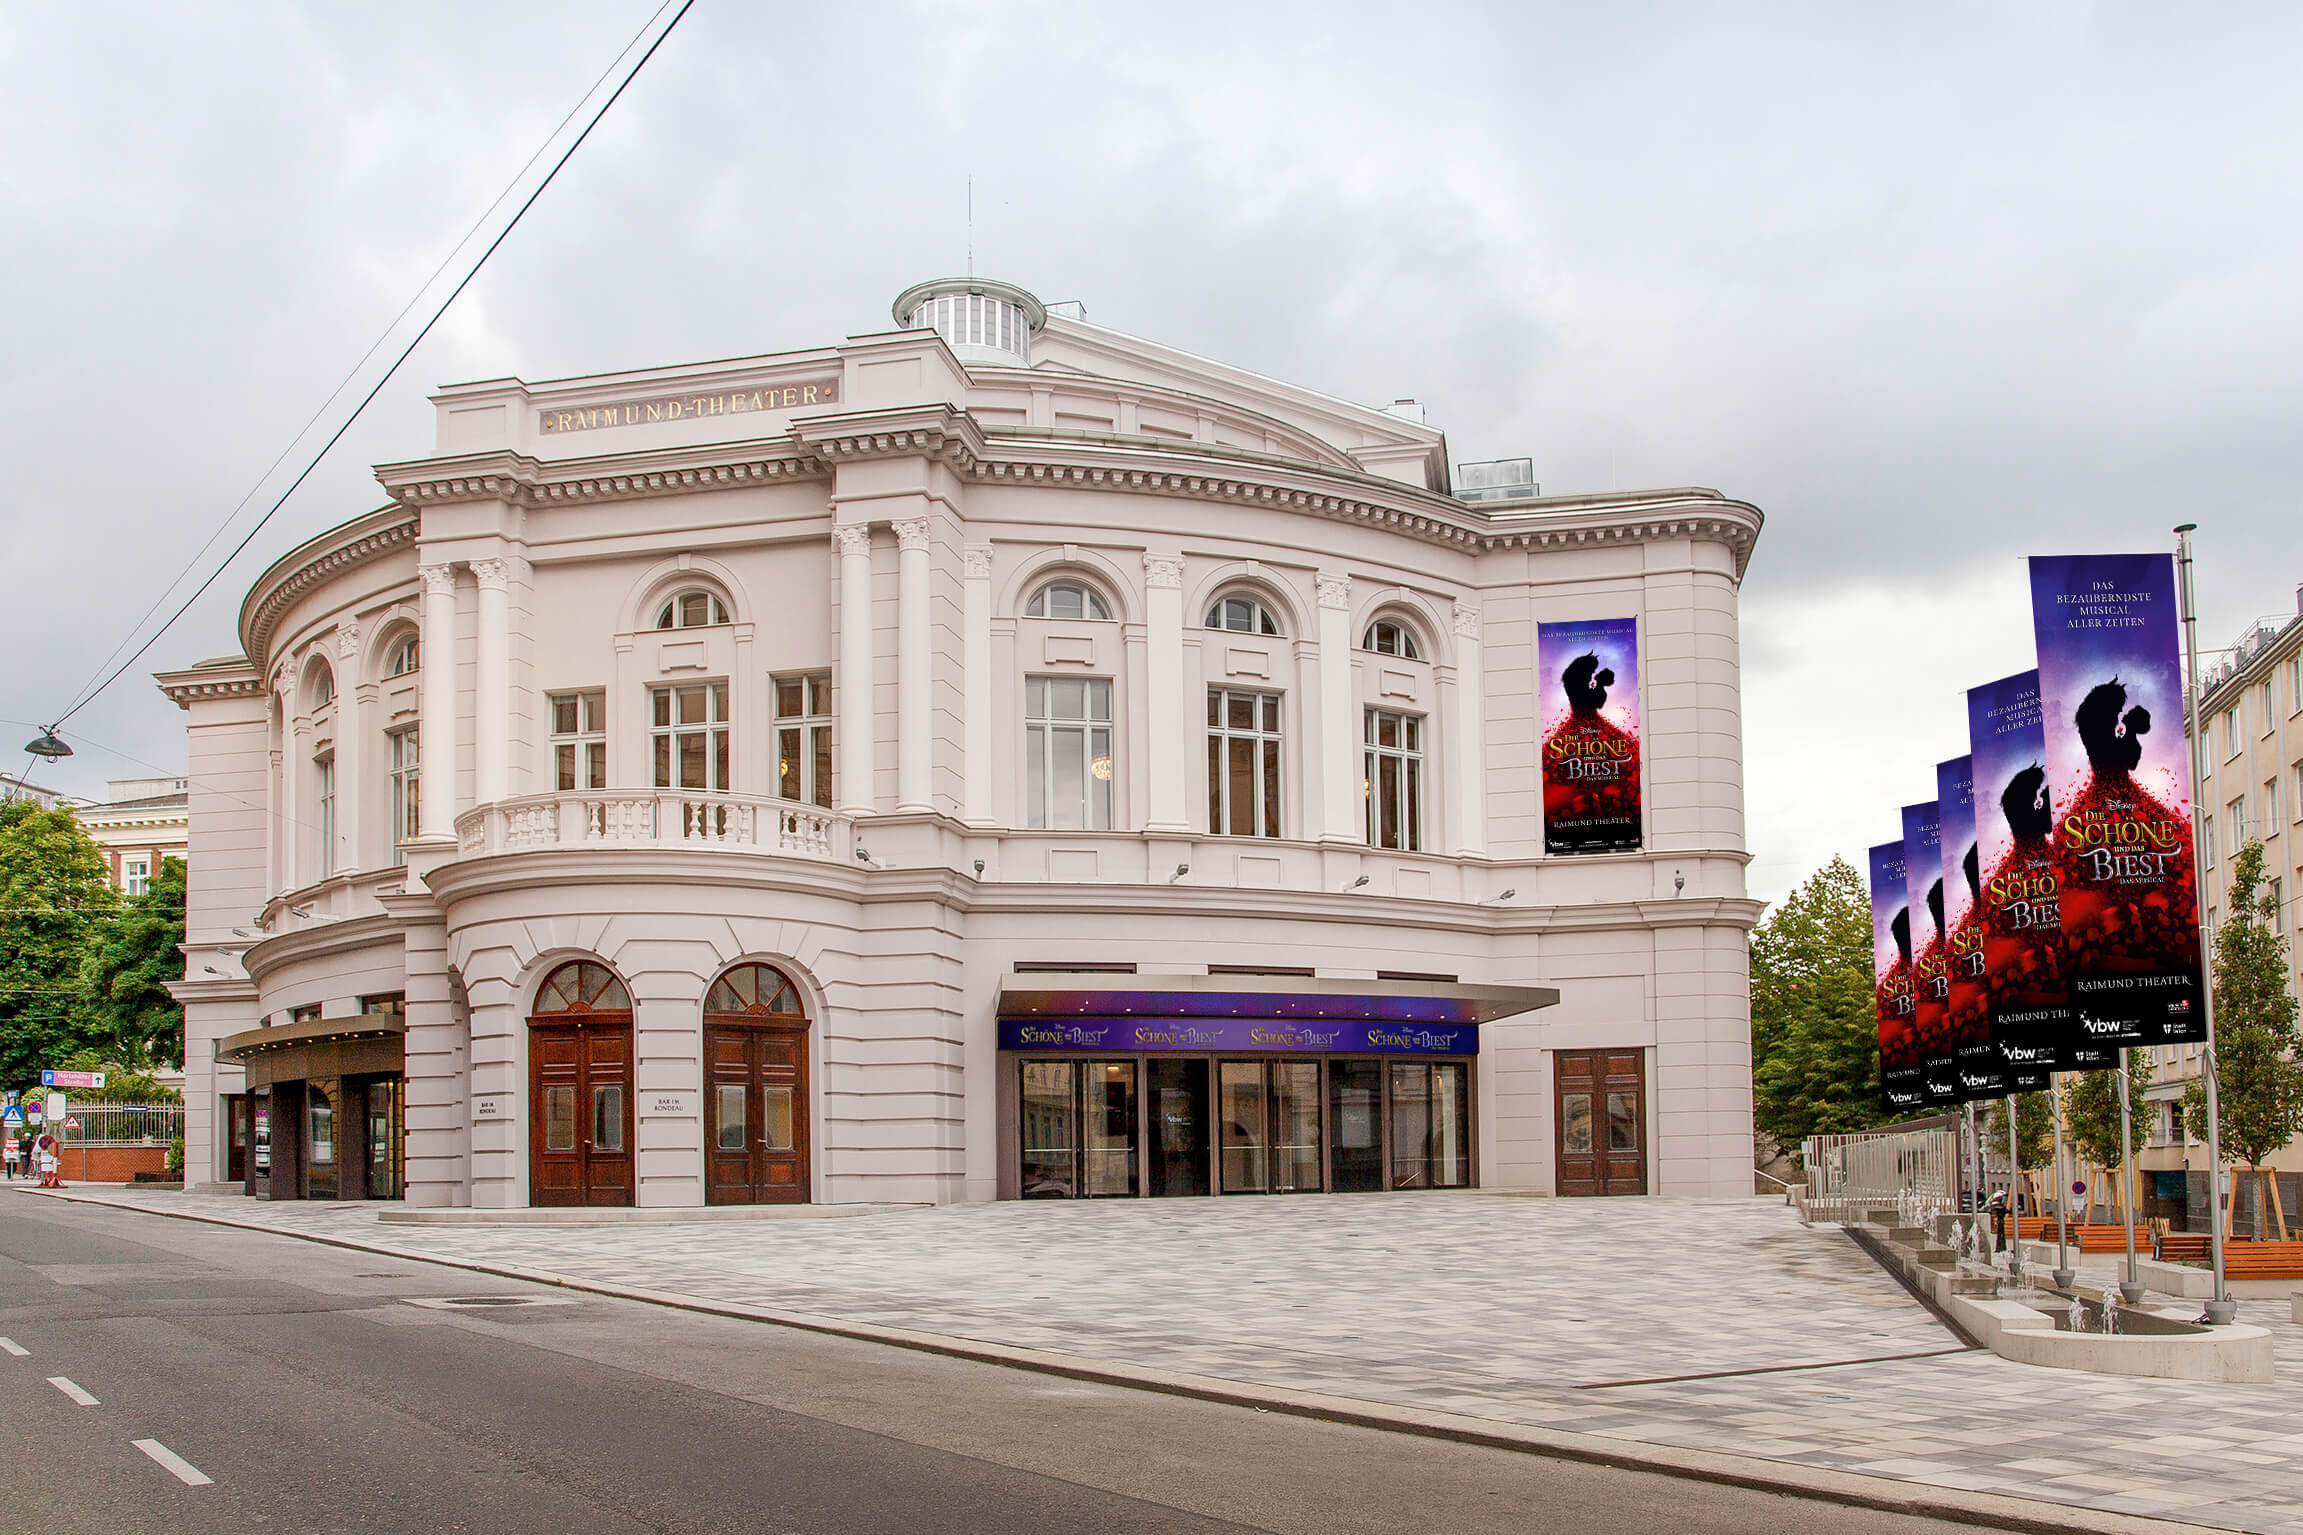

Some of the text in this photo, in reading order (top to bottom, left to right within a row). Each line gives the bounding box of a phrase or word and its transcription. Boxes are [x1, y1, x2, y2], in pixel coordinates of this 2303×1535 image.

[558, 385, 818, 431] RAIMUND-THEATER
[2092, 581, 2114, 591] DAS
[2056, 592, 2152, 604] BEZAUBERNDSTE
[2080, 605, 2130, 615] MUSICAL
[2067, 617, 2145, 628] ALLER ZEITEN
[2016, 689, 2035, 700] DAS
[1996, 720, 2024, 734] ALLER
[1550, 738, 1629, 759] SCHÖNE
[1559, 754, 1632, 779] BIEST
[2105, 800, 2136, 812] Disney
[1554, 817, 1632, 828] RAIMUND THEATER
[2085, 811, 2105, 821] DIE
[2065, 816, 2178, 848] SCHÖNE
[2078, 842, 2182, 880] BIEST
[2008, 872, 2024, 880] DIE
[2077, 976, 2194, 992] RAIMUND THEATER
[1998, 1011, 2048, 1024] RAIMUND
[2087, 1018, 2120, 1033] vbw
[1069, 1026, 1109, 1044] BIEST
[1184, 1027, 1223, 1044] BIEST
[1300, 1028, 1339, 1046] BIEST
[1368, 1030, 1458, 1048] SCHÖNE BIEST
[2006, 1047, 2035, 1060] vbw
[1965, 1075, 1988, 1086] vbw
[1931, 1083, 1952, 1093] vbw
[1893, 1093, 1912, 1102] vbw
